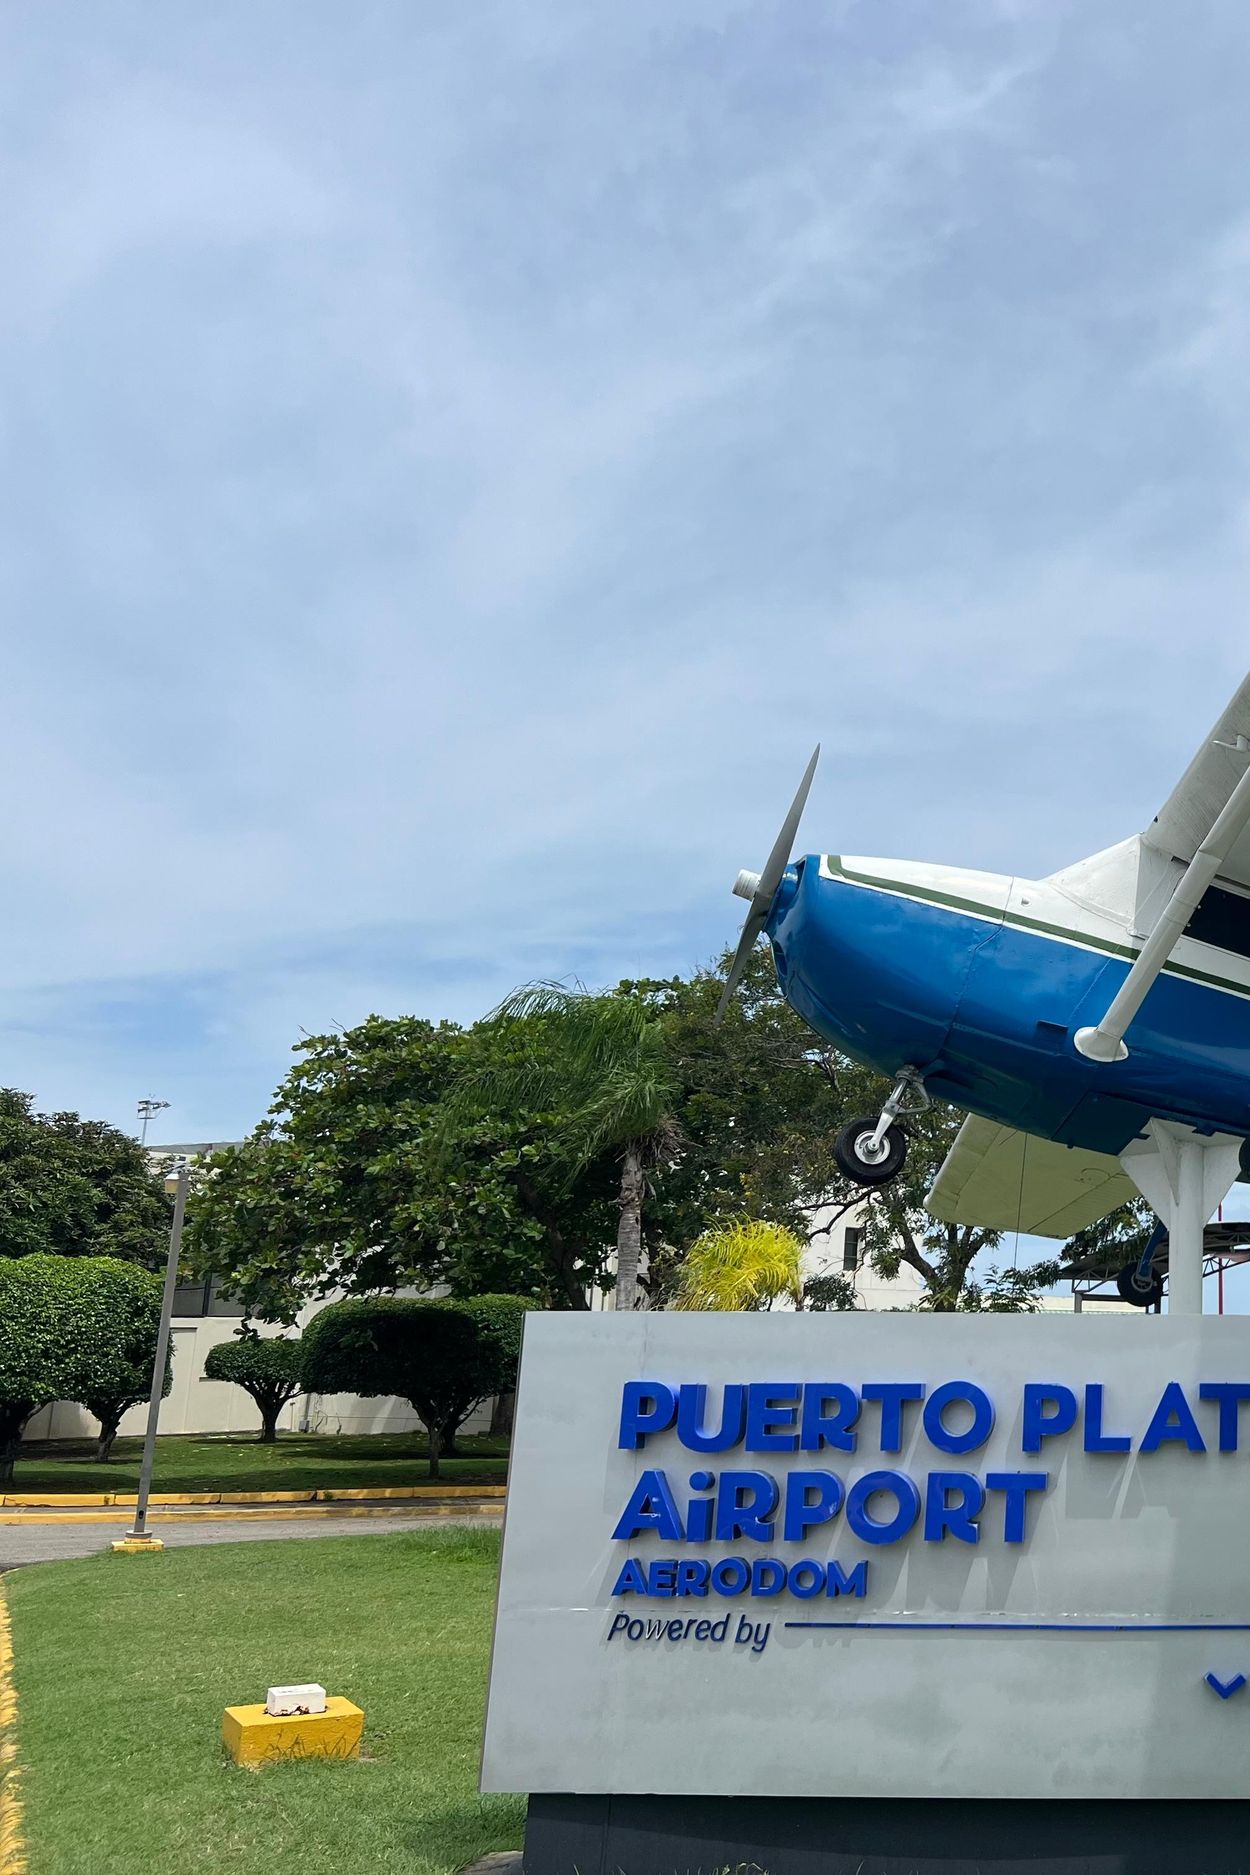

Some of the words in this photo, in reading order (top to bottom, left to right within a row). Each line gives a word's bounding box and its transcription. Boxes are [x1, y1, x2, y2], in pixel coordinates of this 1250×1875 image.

[618, 1380, 996, 1455] PUERTO
[611, 1556, 869, 1600] AERODOM
[607, 1613, 731, 1642] Powered
[734, 1614, 771, 1653] by
